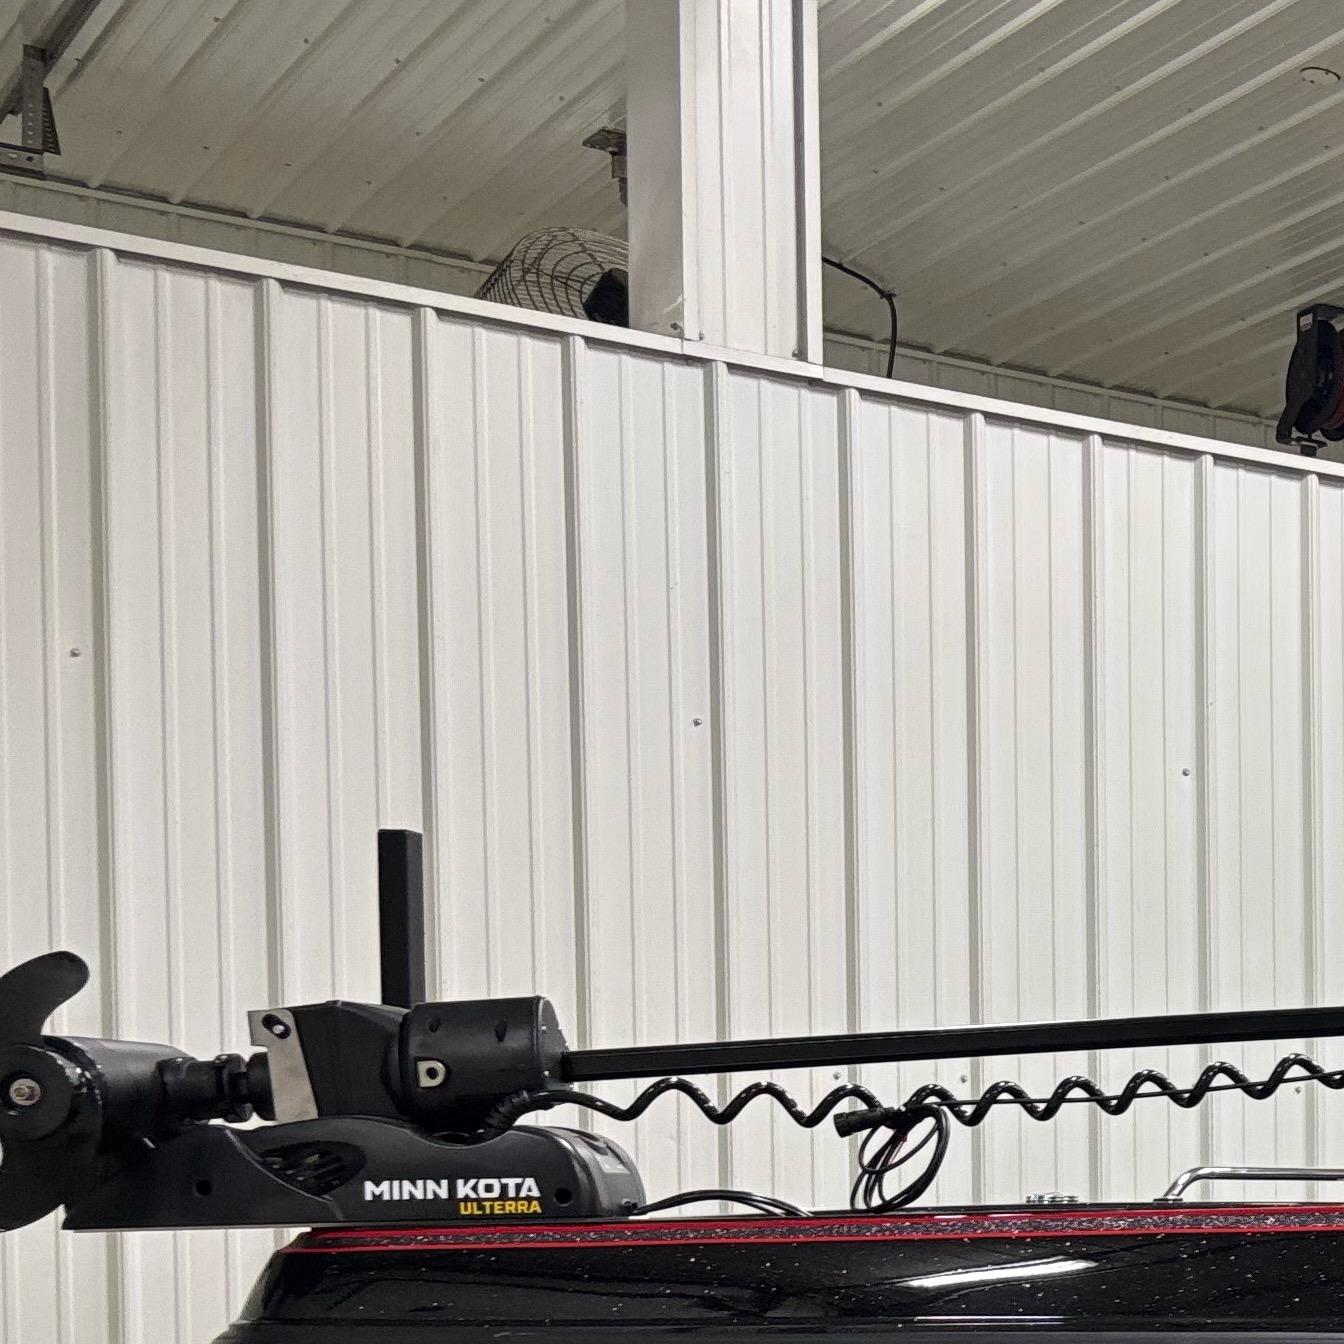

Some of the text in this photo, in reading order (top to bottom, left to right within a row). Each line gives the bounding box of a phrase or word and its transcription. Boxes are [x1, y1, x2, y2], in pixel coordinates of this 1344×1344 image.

[364, 1177, 541, 1200] MINN KOTA
[459, 1200, 542, 1215] ULTERRA
